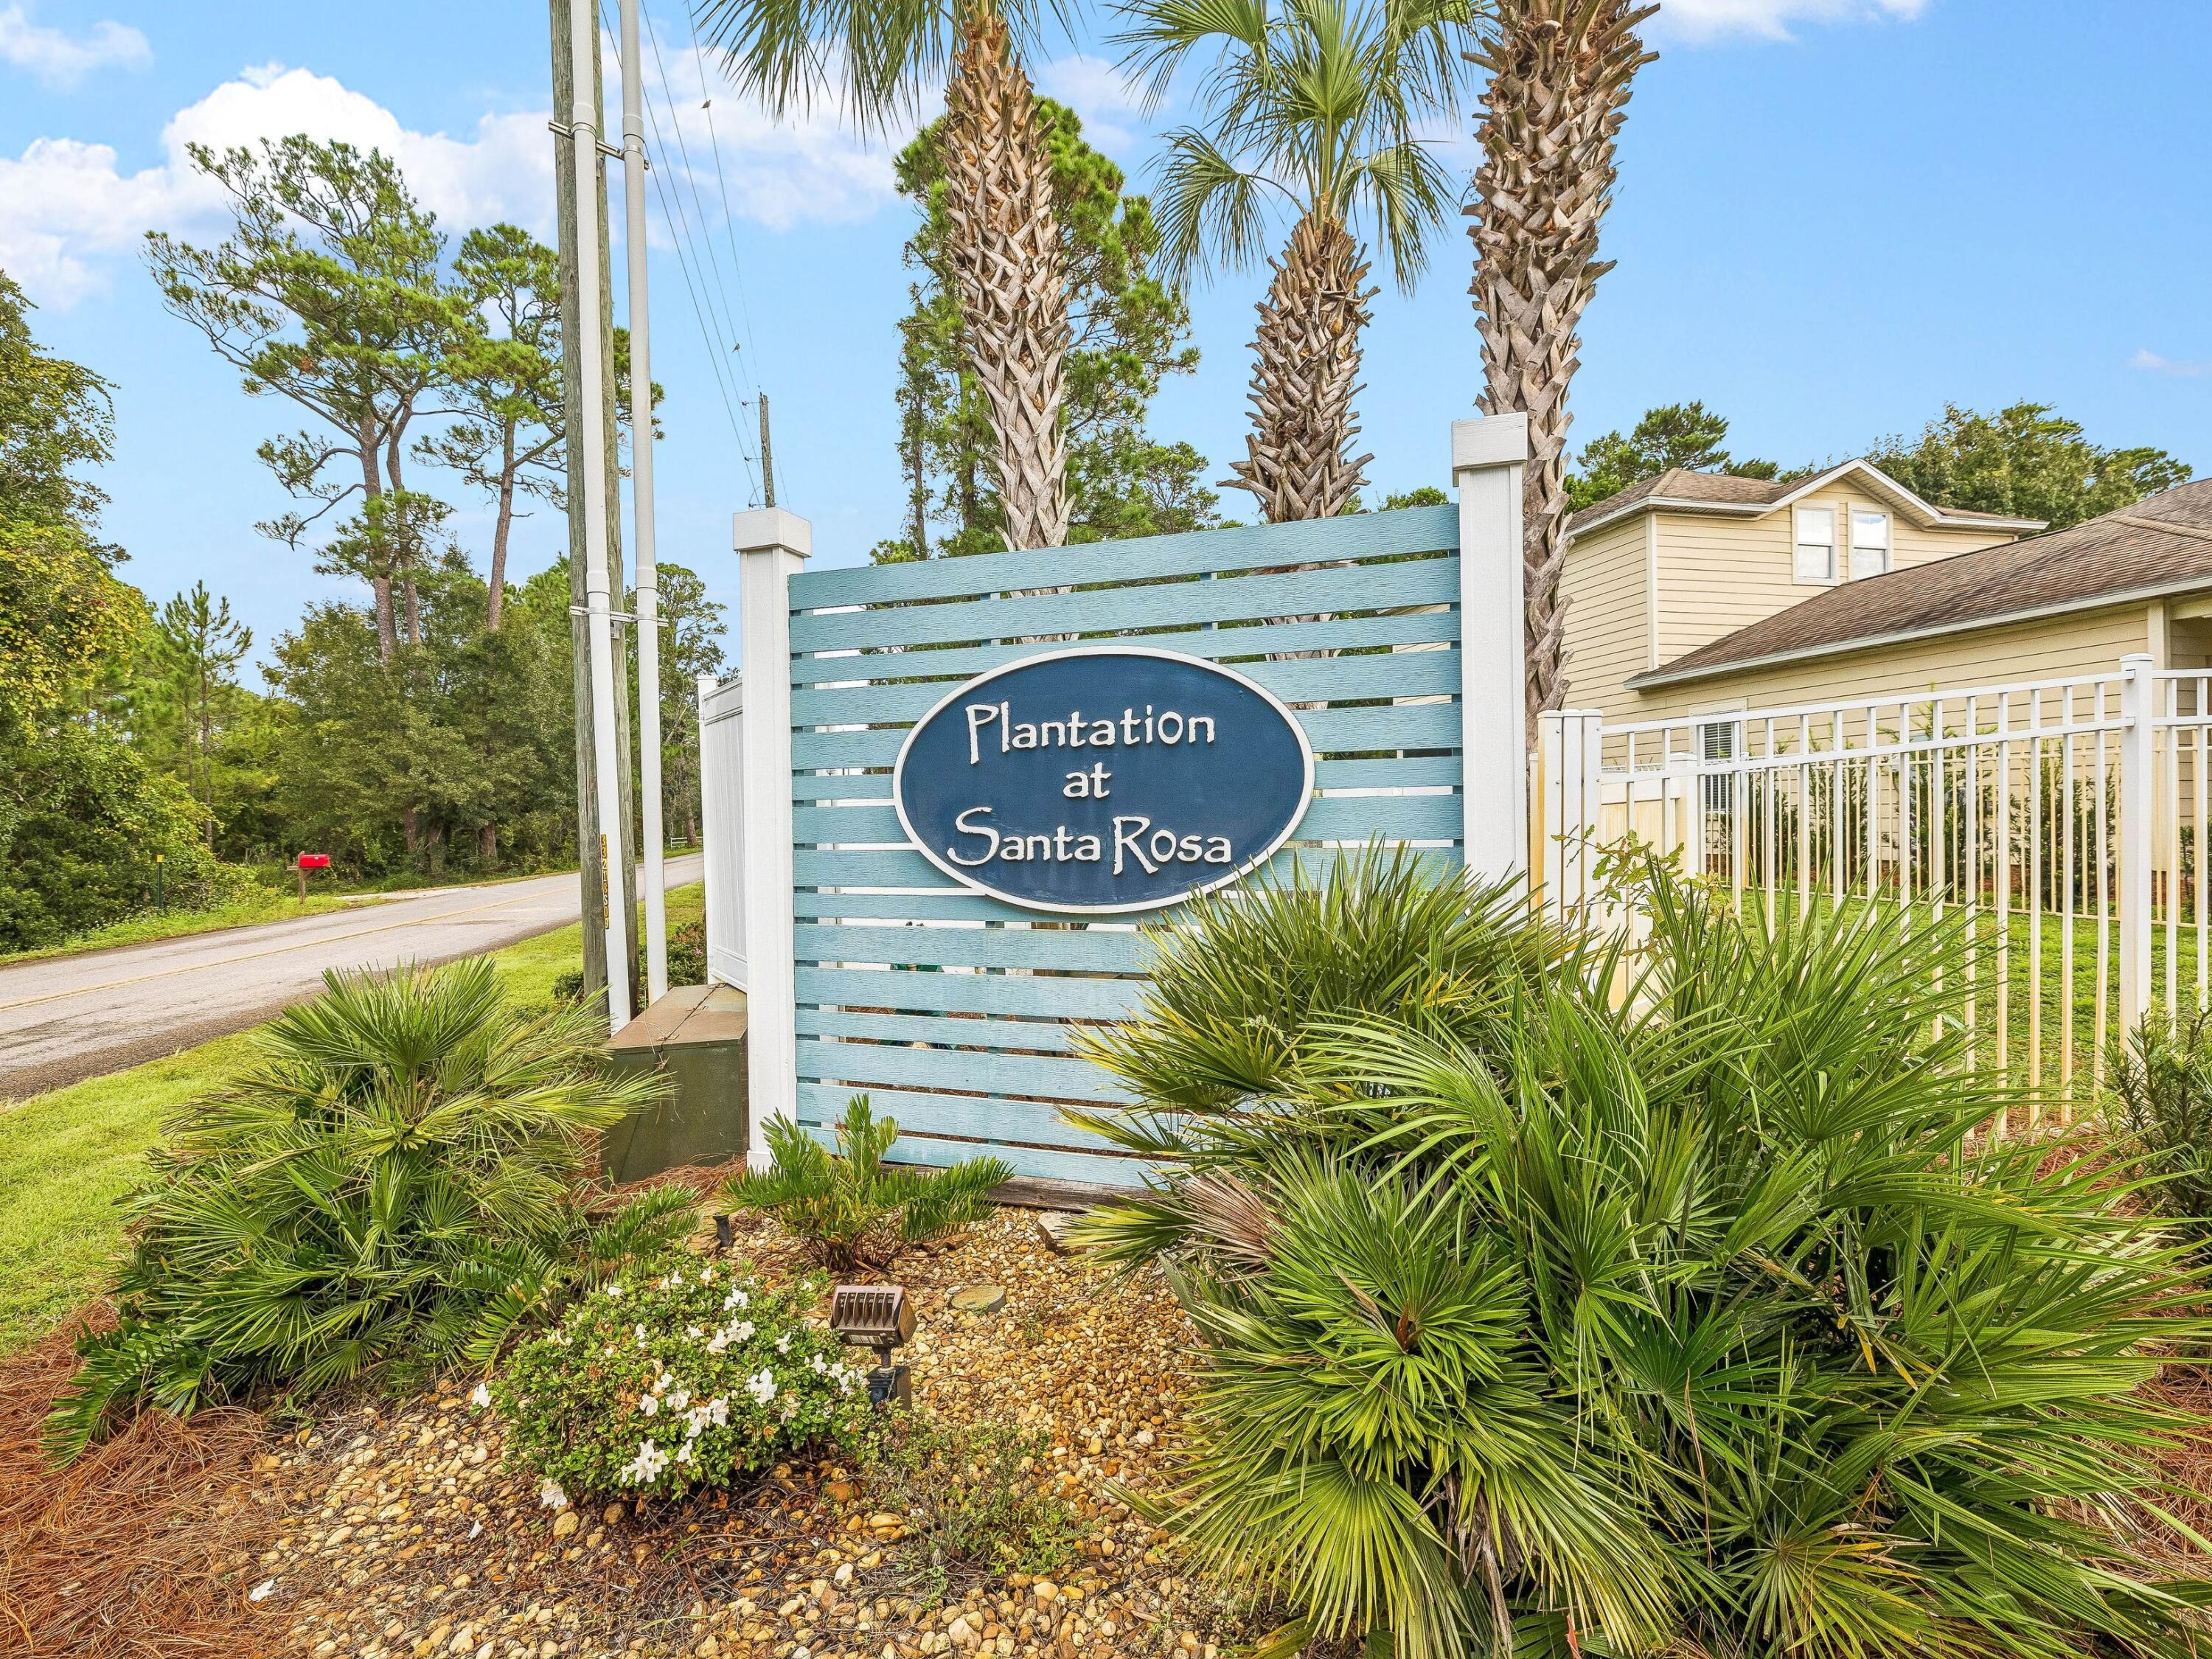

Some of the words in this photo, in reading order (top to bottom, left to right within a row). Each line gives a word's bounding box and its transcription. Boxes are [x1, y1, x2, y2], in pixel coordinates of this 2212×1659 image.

[965, 700, 1216, 765] Plantation
[1062, 762, 1112, 798] at
[947, 807, 1102, 866] Santa
[1112, 815, 1232, 876] Rosa
